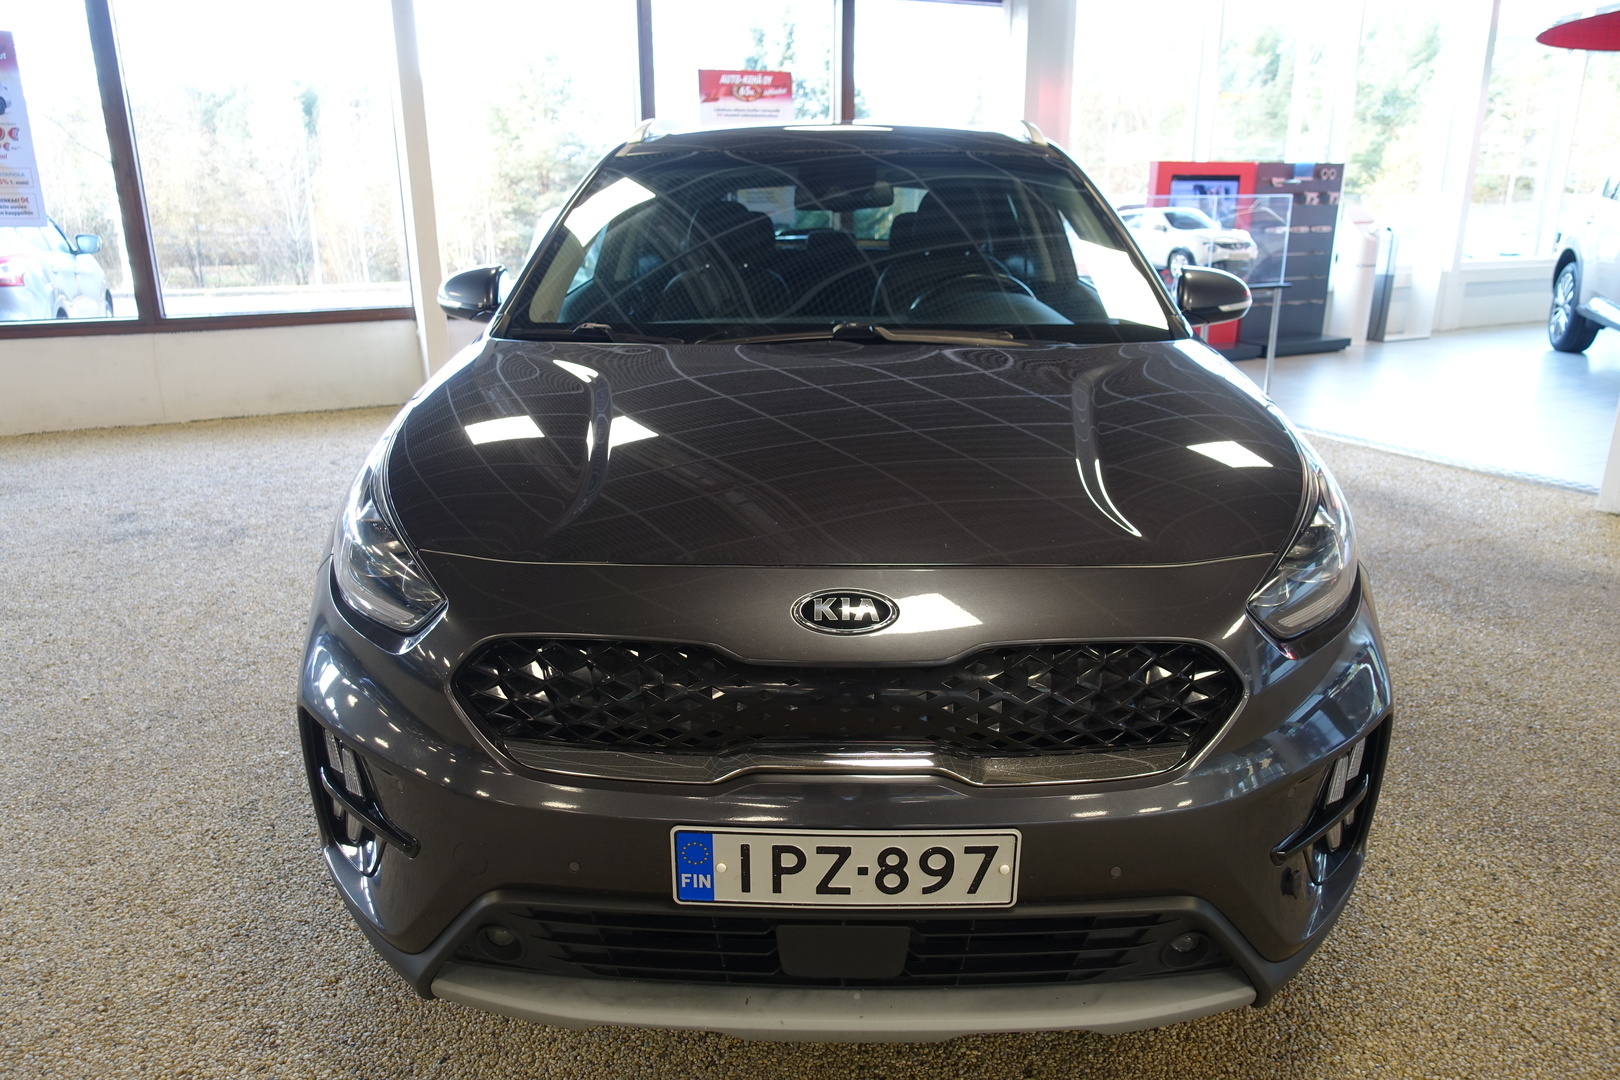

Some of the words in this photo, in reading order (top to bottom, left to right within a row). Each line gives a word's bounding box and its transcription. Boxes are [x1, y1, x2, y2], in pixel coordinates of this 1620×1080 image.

[813, 597, 880, 622] KIA
[681, 873, 712, 889] FIN
[740, 843, 1000, 895] IPZ-897
